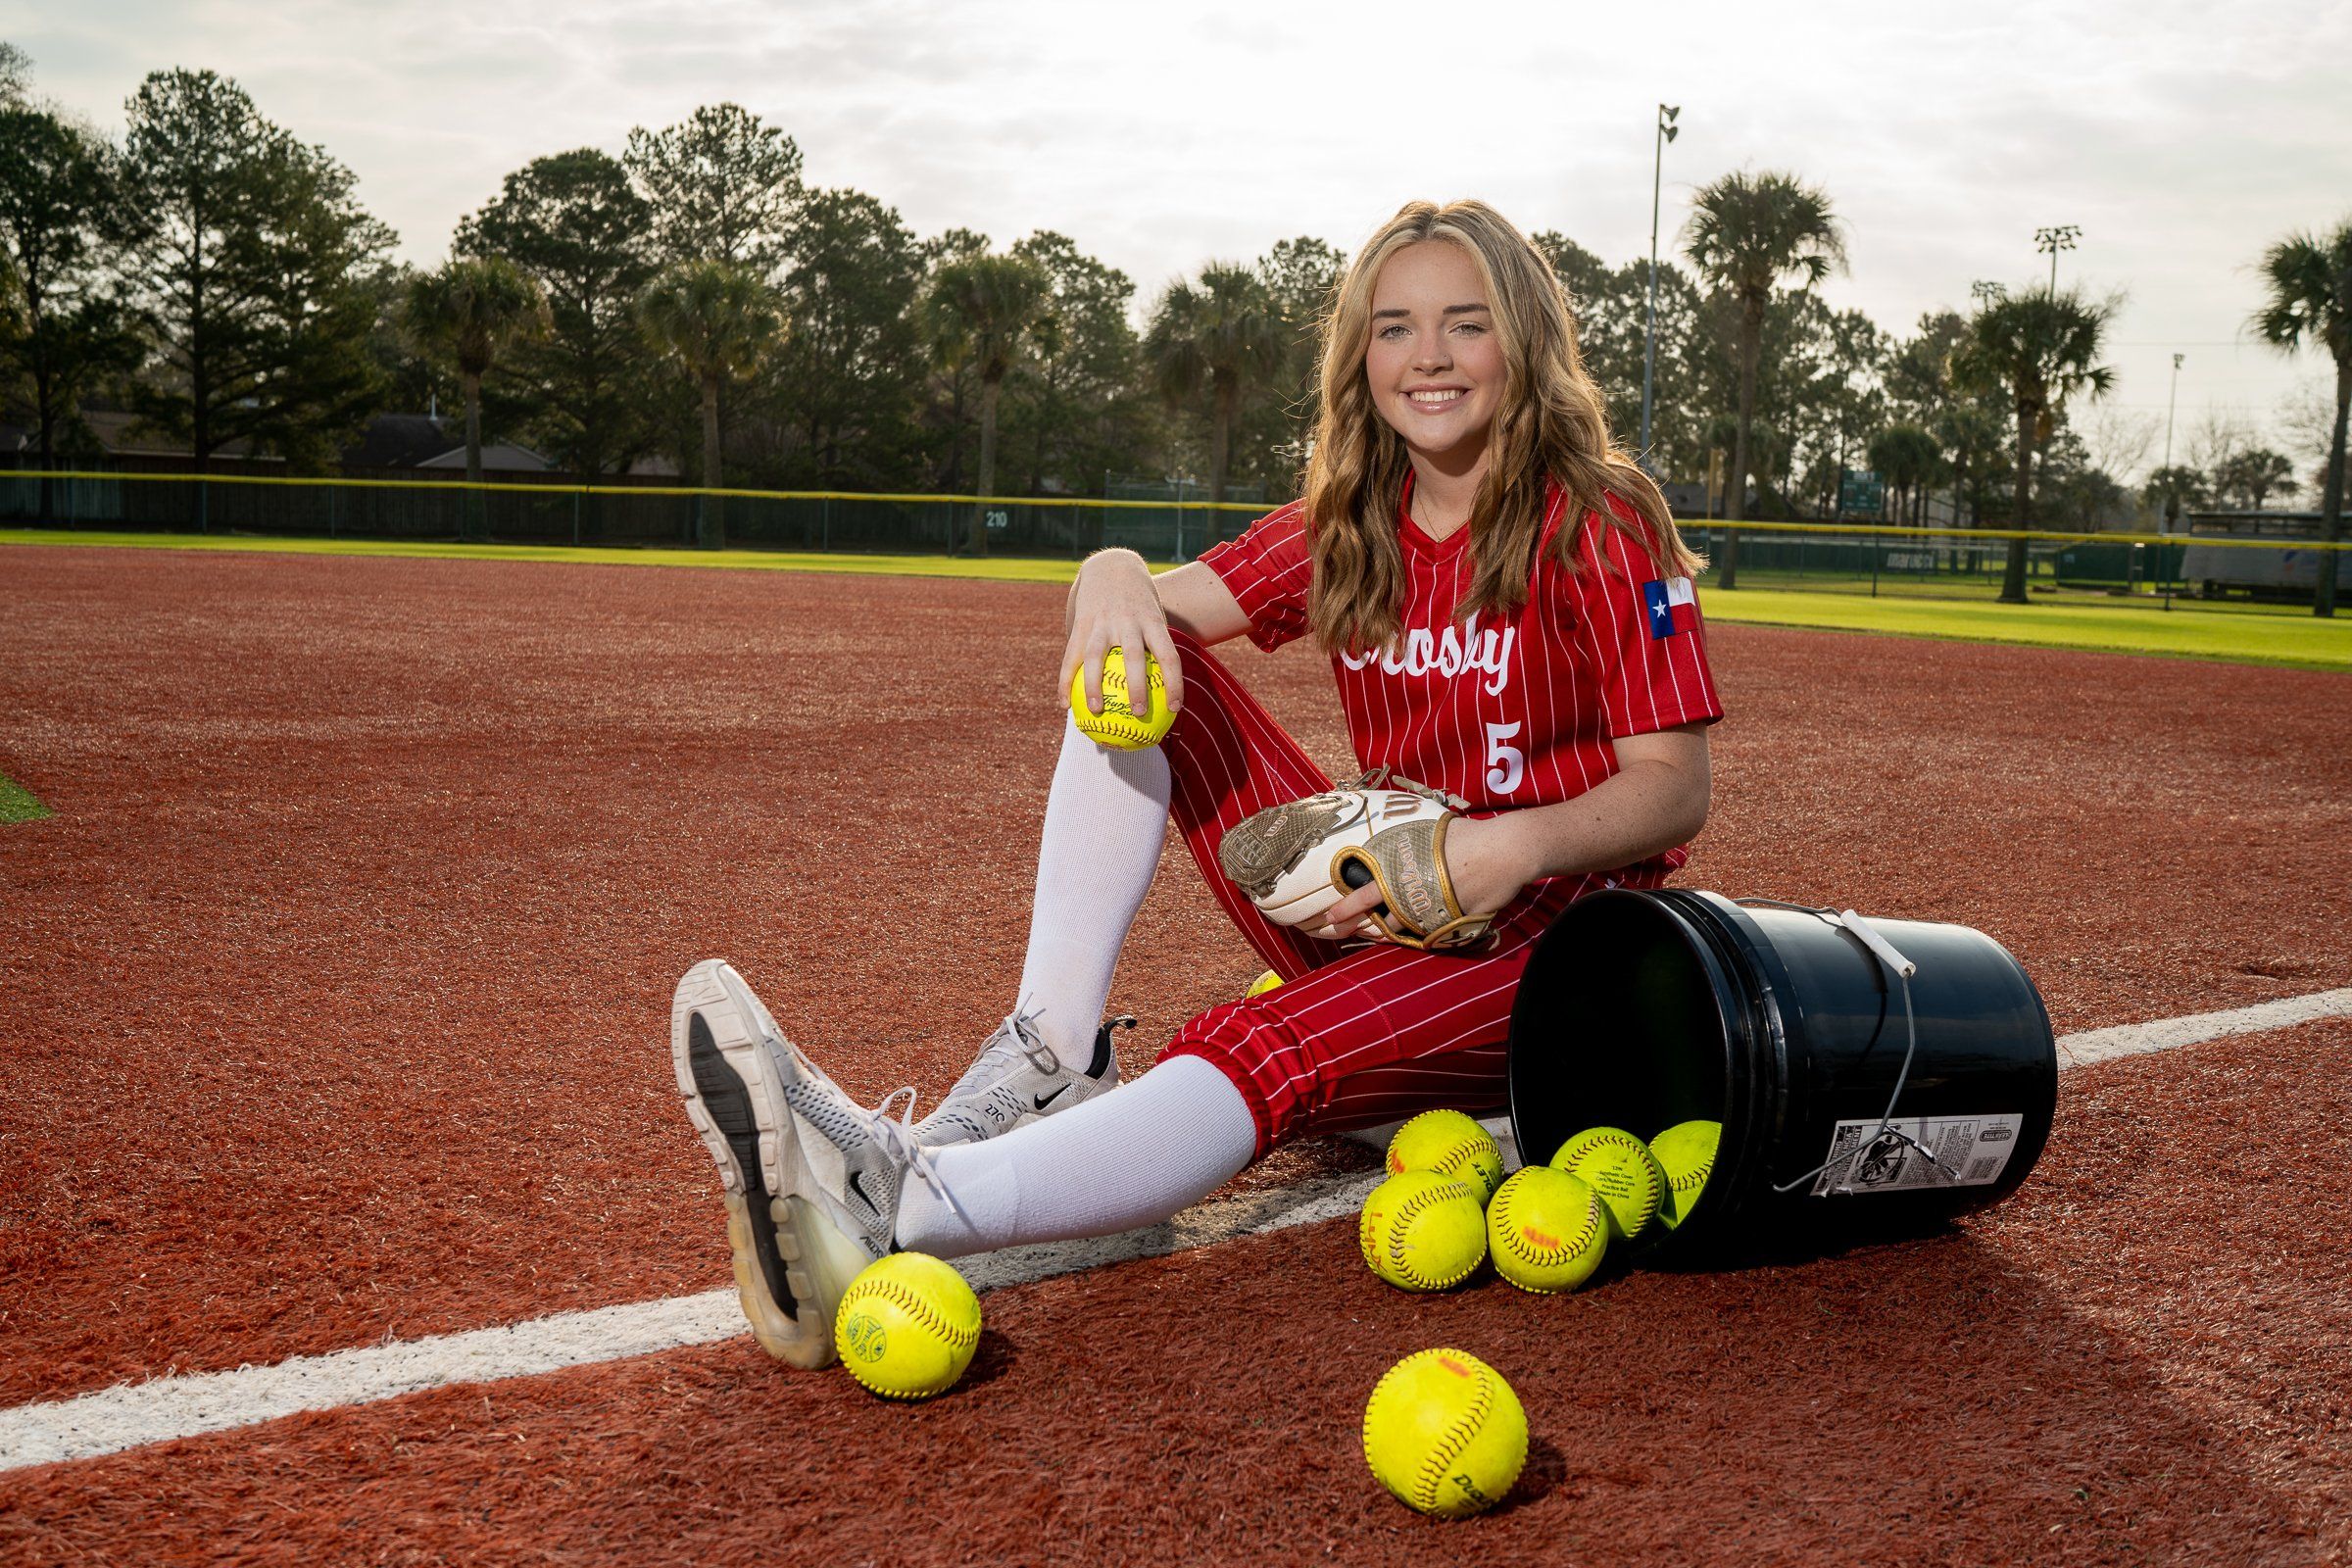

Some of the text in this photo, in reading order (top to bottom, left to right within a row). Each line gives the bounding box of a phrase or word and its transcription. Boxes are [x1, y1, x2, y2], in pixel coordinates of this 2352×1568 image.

[986, 511, 1007, 527] 210
[1485, 719, 1524, 795] 5
[1396, 832, 1432, 916] Wilson
[1471, 1161, 1494, 1195] DLEY
